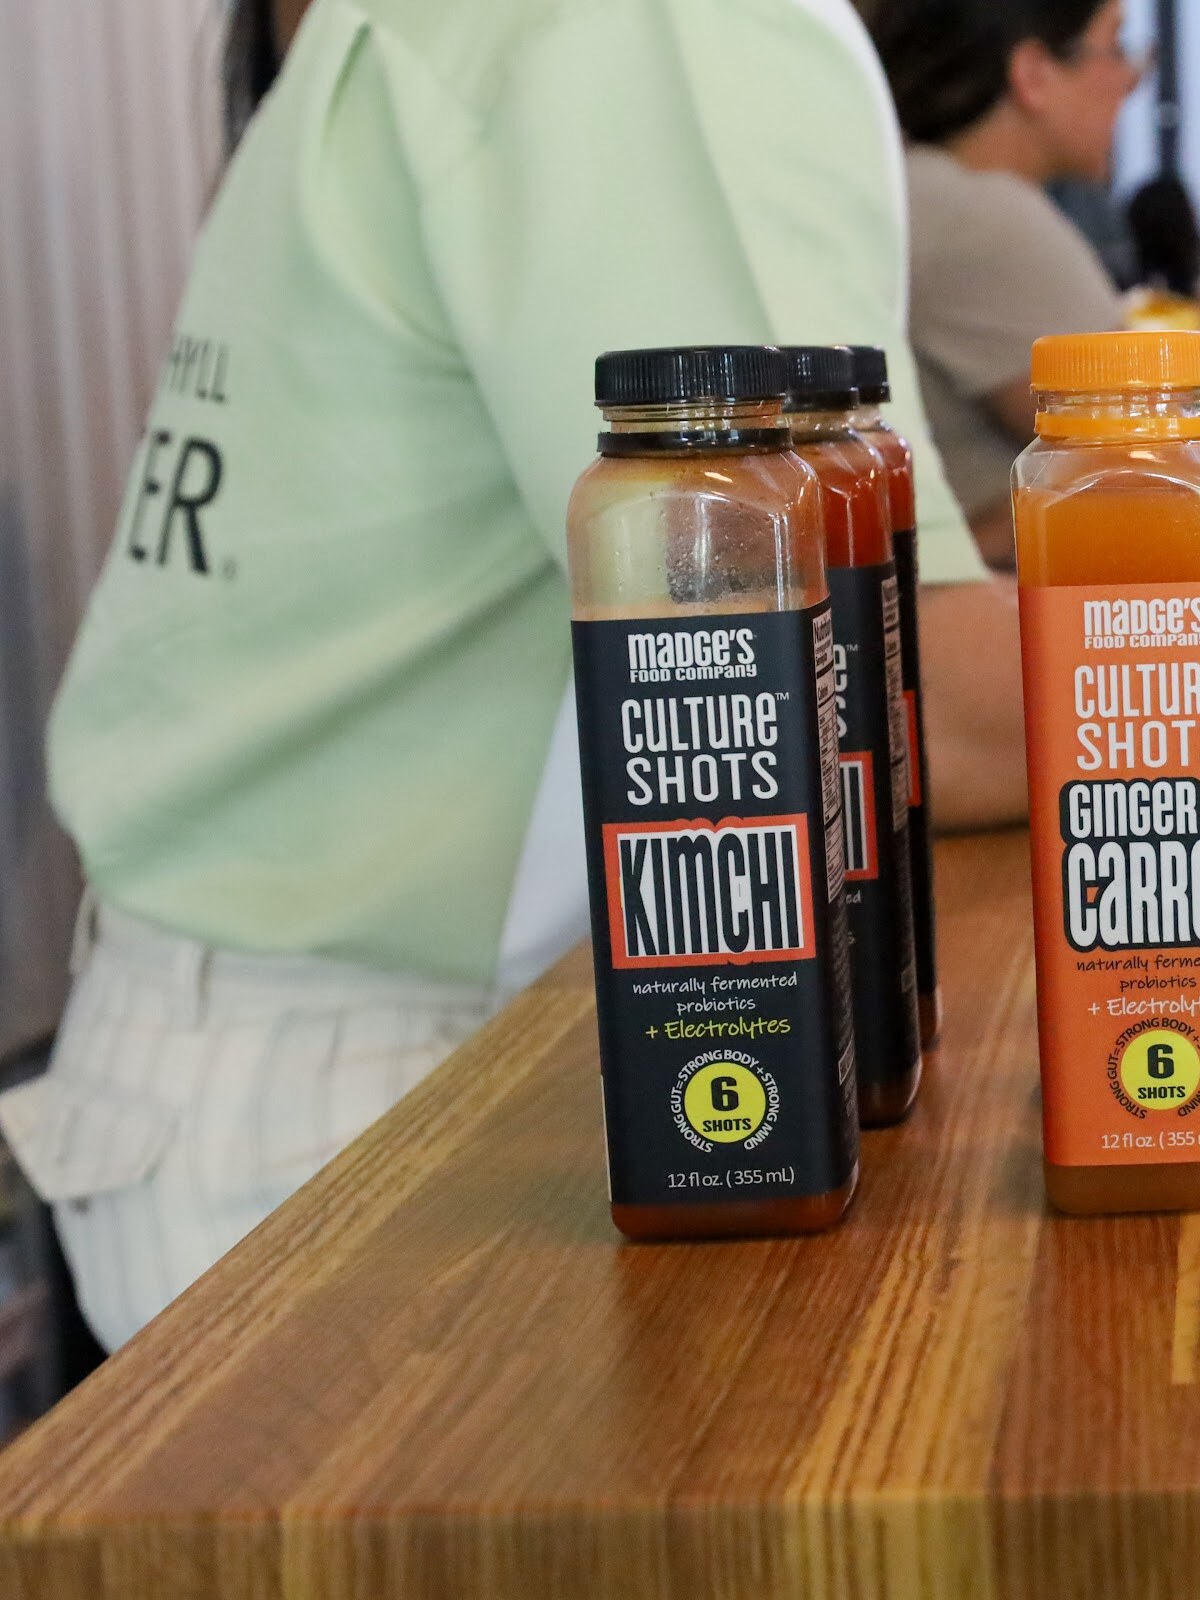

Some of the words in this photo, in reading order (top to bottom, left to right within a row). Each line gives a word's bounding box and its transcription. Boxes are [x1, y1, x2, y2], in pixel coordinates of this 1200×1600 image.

[1084, 634, 1125, 649] FOOD
[630, 668, 671, 683] FOOD
[626, 750, 779, 806] SHOTS
[1076, 955, 1148, 972] naturally
[632, 978, 706, 995] naturally
[710, 971, 798, 992] fermented
[1119, 975, 1197, 992] probiotics
[676, 997, 756, 1016] probiotics
[663, 1016, 791, 1040] Electrolytes
[1115, 1017, 1160, 1049] STRONG
[1161, 1017, 1196, 1037] BODY
[677, 1049, 723, 1082] STRONG
[723, 1049, 760, 1069] BODY
[1146, 1043, 1175, 1079] 6
[710, 1076, 740, 1112] 6
[761, 1072, 780, 1122] STRONG
[1109, 1079, 1148, 1120] STRONG
[1137, 1085, 1186, 1100] SHOTS
[673, 1112, 714, 1153] STRONG
[702, 1117, 752, 1133] SHOTS
[743, 1122, 773, 1151] MIND
[1101, 1134, 1121, 1149] 12
[667, 1173, 687, 1188] 12
